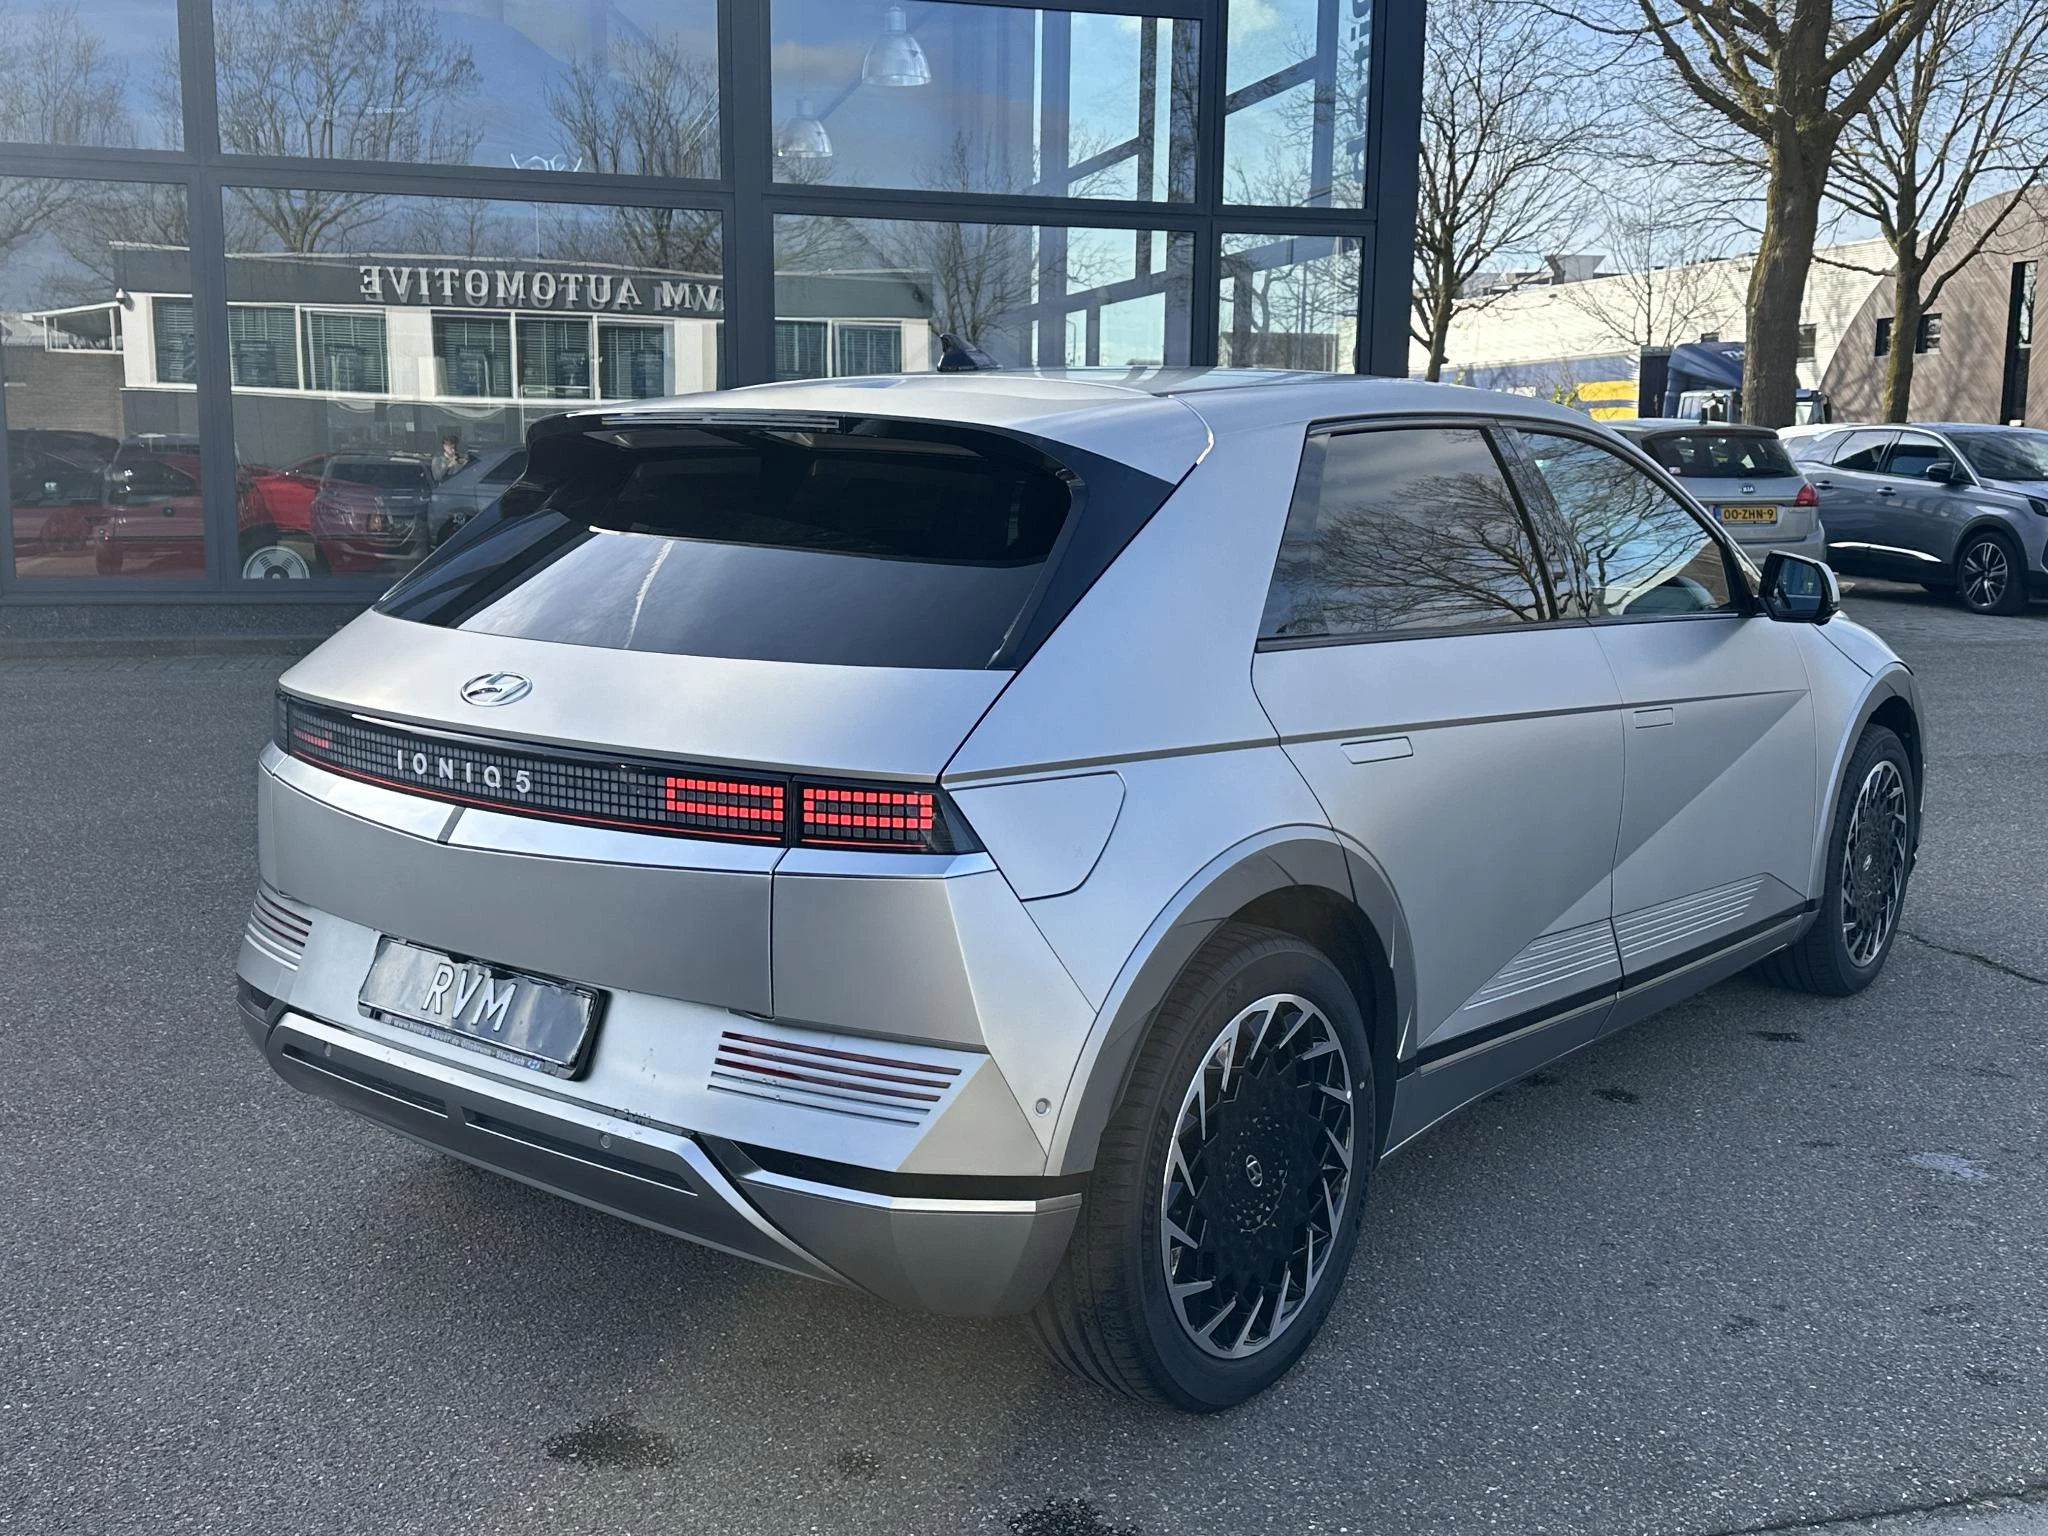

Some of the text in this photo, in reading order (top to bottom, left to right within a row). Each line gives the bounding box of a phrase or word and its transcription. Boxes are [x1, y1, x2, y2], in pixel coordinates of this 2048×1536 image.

[1723, 508, 1774, 520] 00-ZHN-9
[397, 749, 531, 793] IONIQ 5
[420, 962, 518, 1033] RVM
